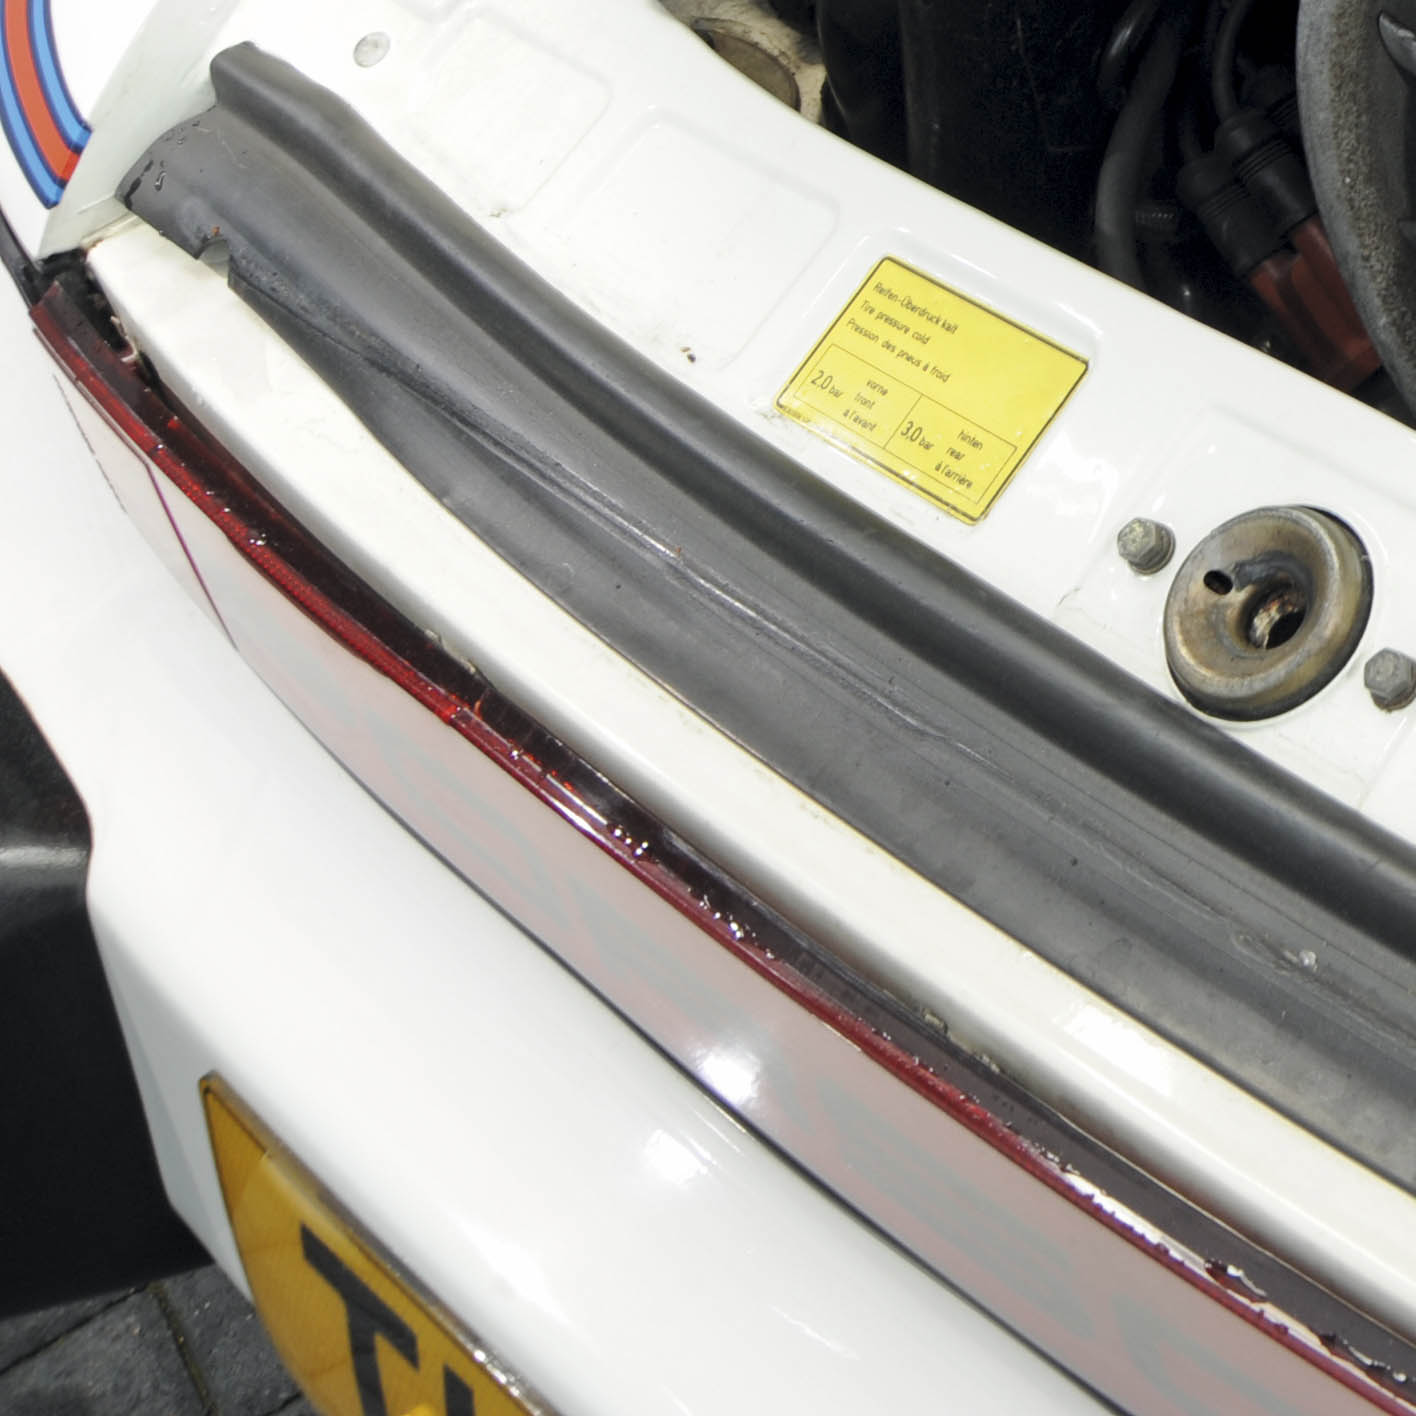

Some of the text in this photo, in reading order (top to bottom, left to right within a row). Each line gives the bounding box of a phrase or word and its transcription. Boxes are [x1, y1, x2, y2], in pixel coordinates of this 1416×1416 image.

[859, 300, 931, 345] Tire pressure cold
[846, 318, 880, 342] Pression
[880, 337, 898, 352] des
[896, 348, 922, 368] pneus
[929, 364, 952, 382] froid
[827, 384, 844, 398] bar
[865, 378, 888, 396] vorne
[854, 392, 876, 409] front
[917, 436, 935, 451] bar
[957, 430, 984, 450] hinten
[946, 446, 964, 461] rear
[301, 1223, 474, 1416] T
